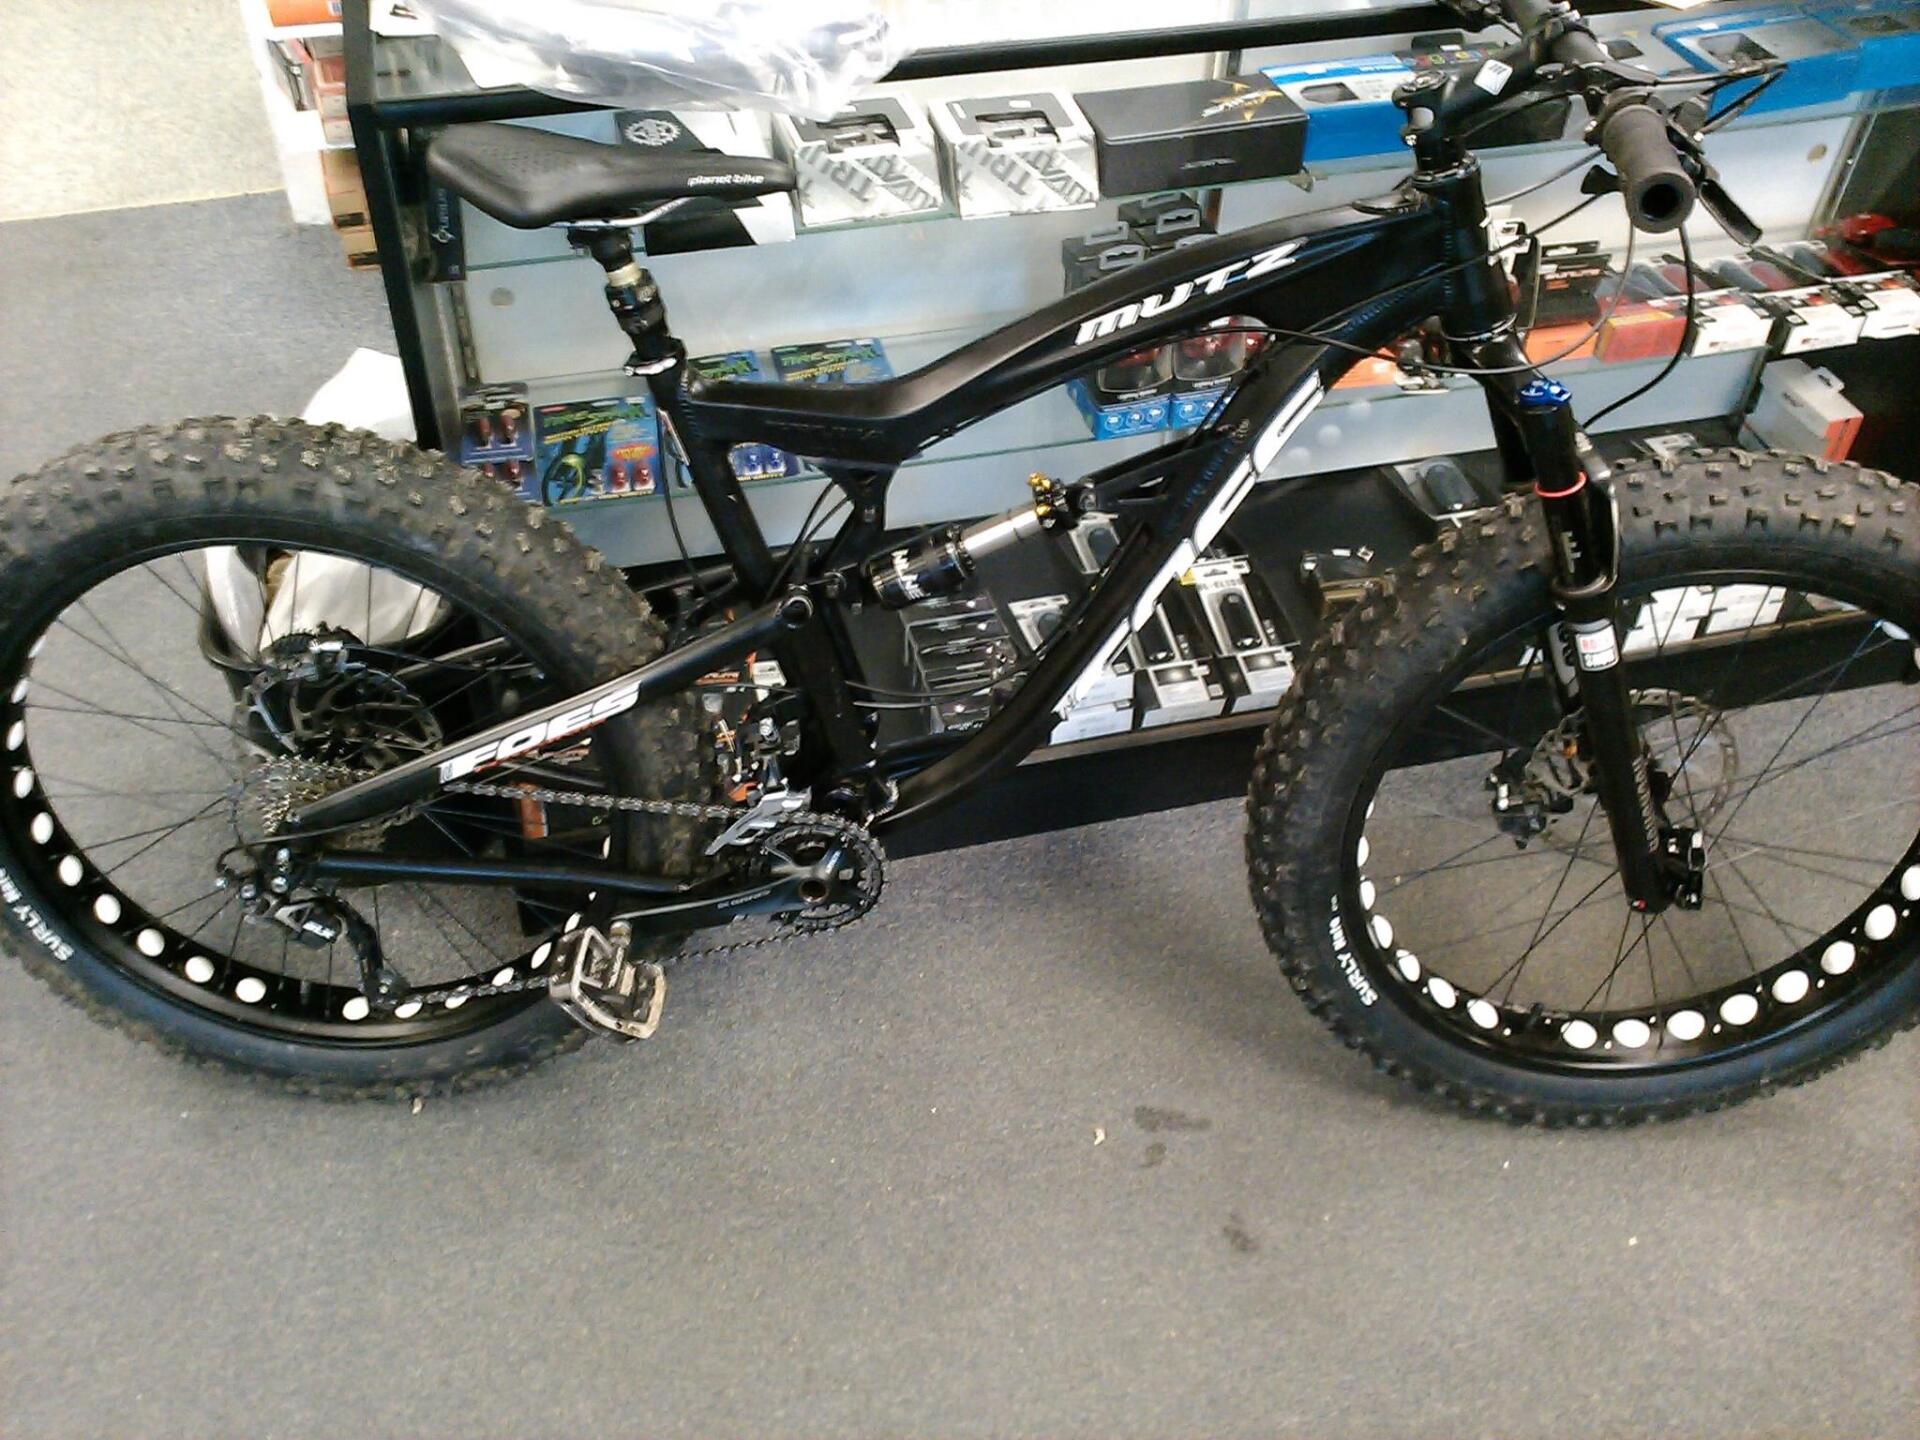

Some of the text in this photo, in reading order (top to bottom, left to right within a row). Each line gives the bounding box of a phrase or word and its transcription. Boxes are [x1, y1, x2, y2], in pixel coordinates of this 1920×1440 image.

[1075, 243, 1308, 345] MUTZ
[437, 679, 642, 785] FOES
[12, 904, 74, 961] SURLY
[1336, 952, 1378, 1006] SURLY
